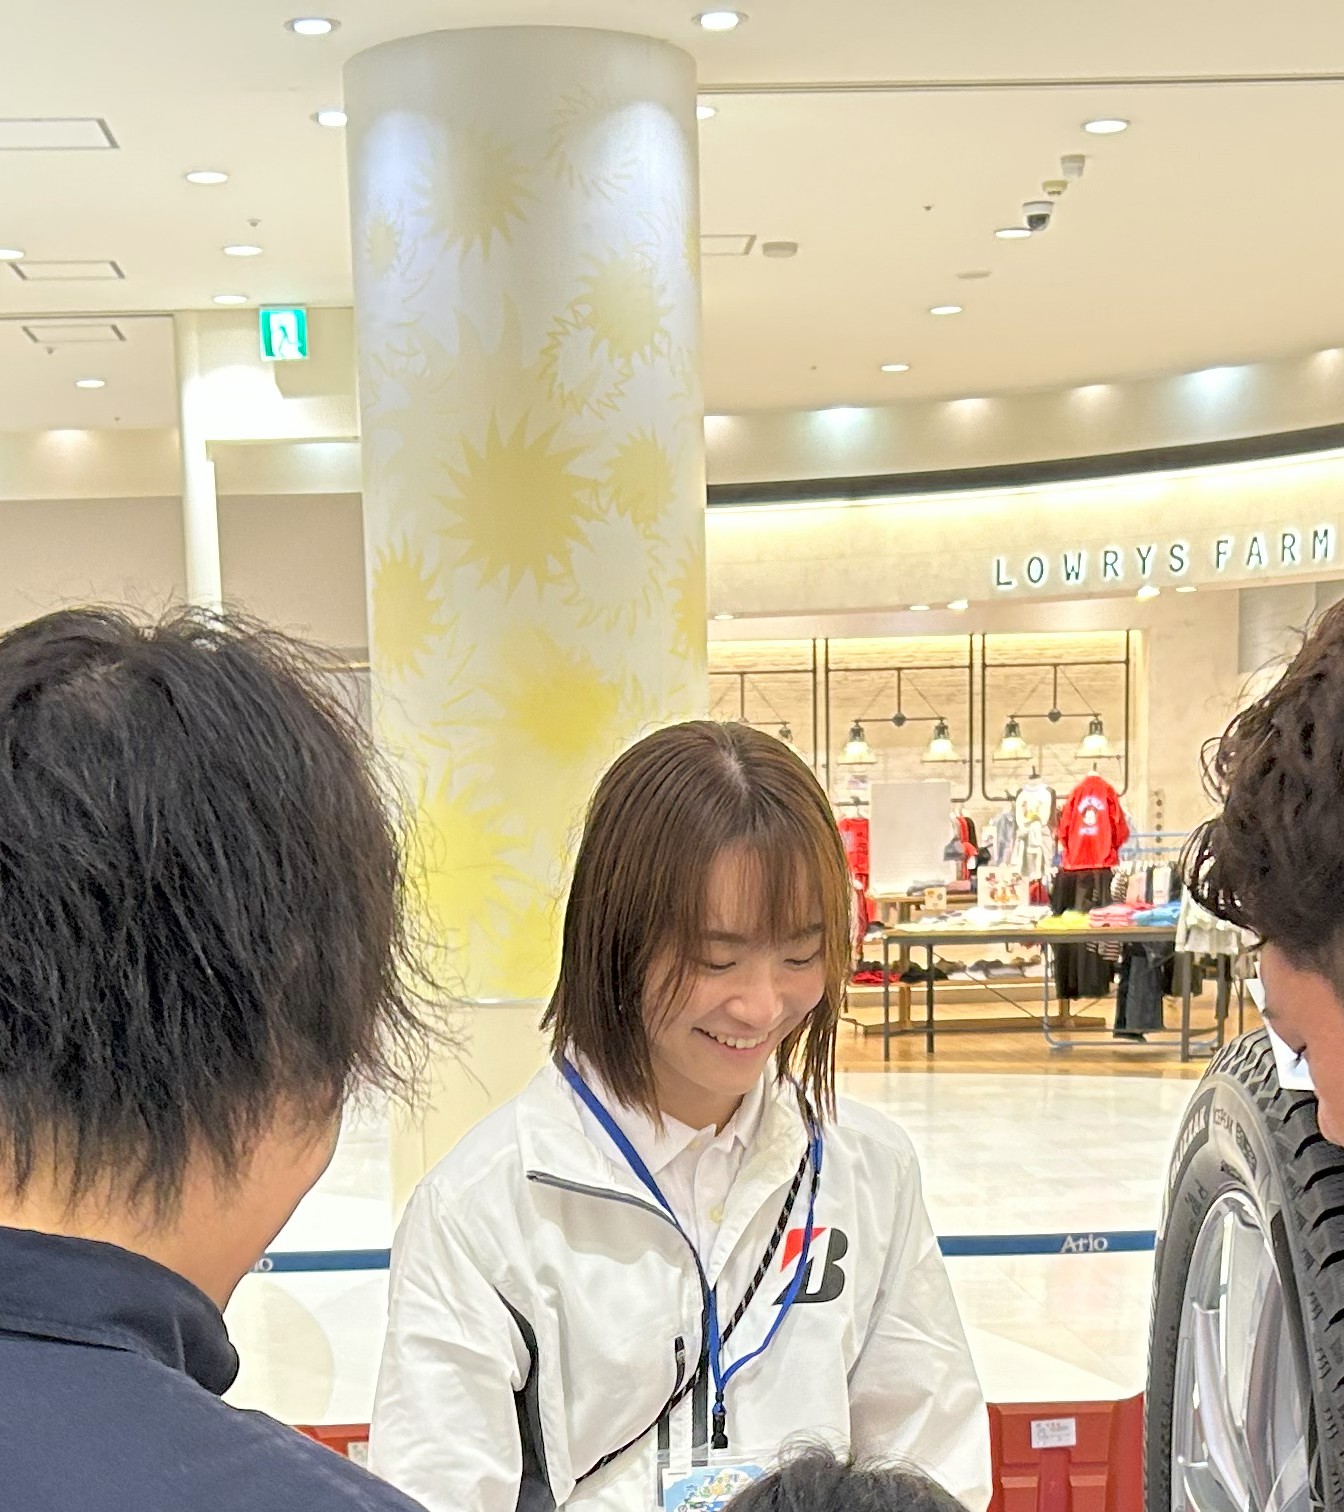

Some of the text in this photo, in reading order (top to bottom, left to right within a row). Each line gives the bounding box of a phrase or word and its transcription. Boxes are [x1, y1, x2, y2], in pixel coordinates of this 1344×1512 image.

[995, 528, 1331, 587] LOWRYS FARM
[1060, 1234, 1108, 1253] Ario
